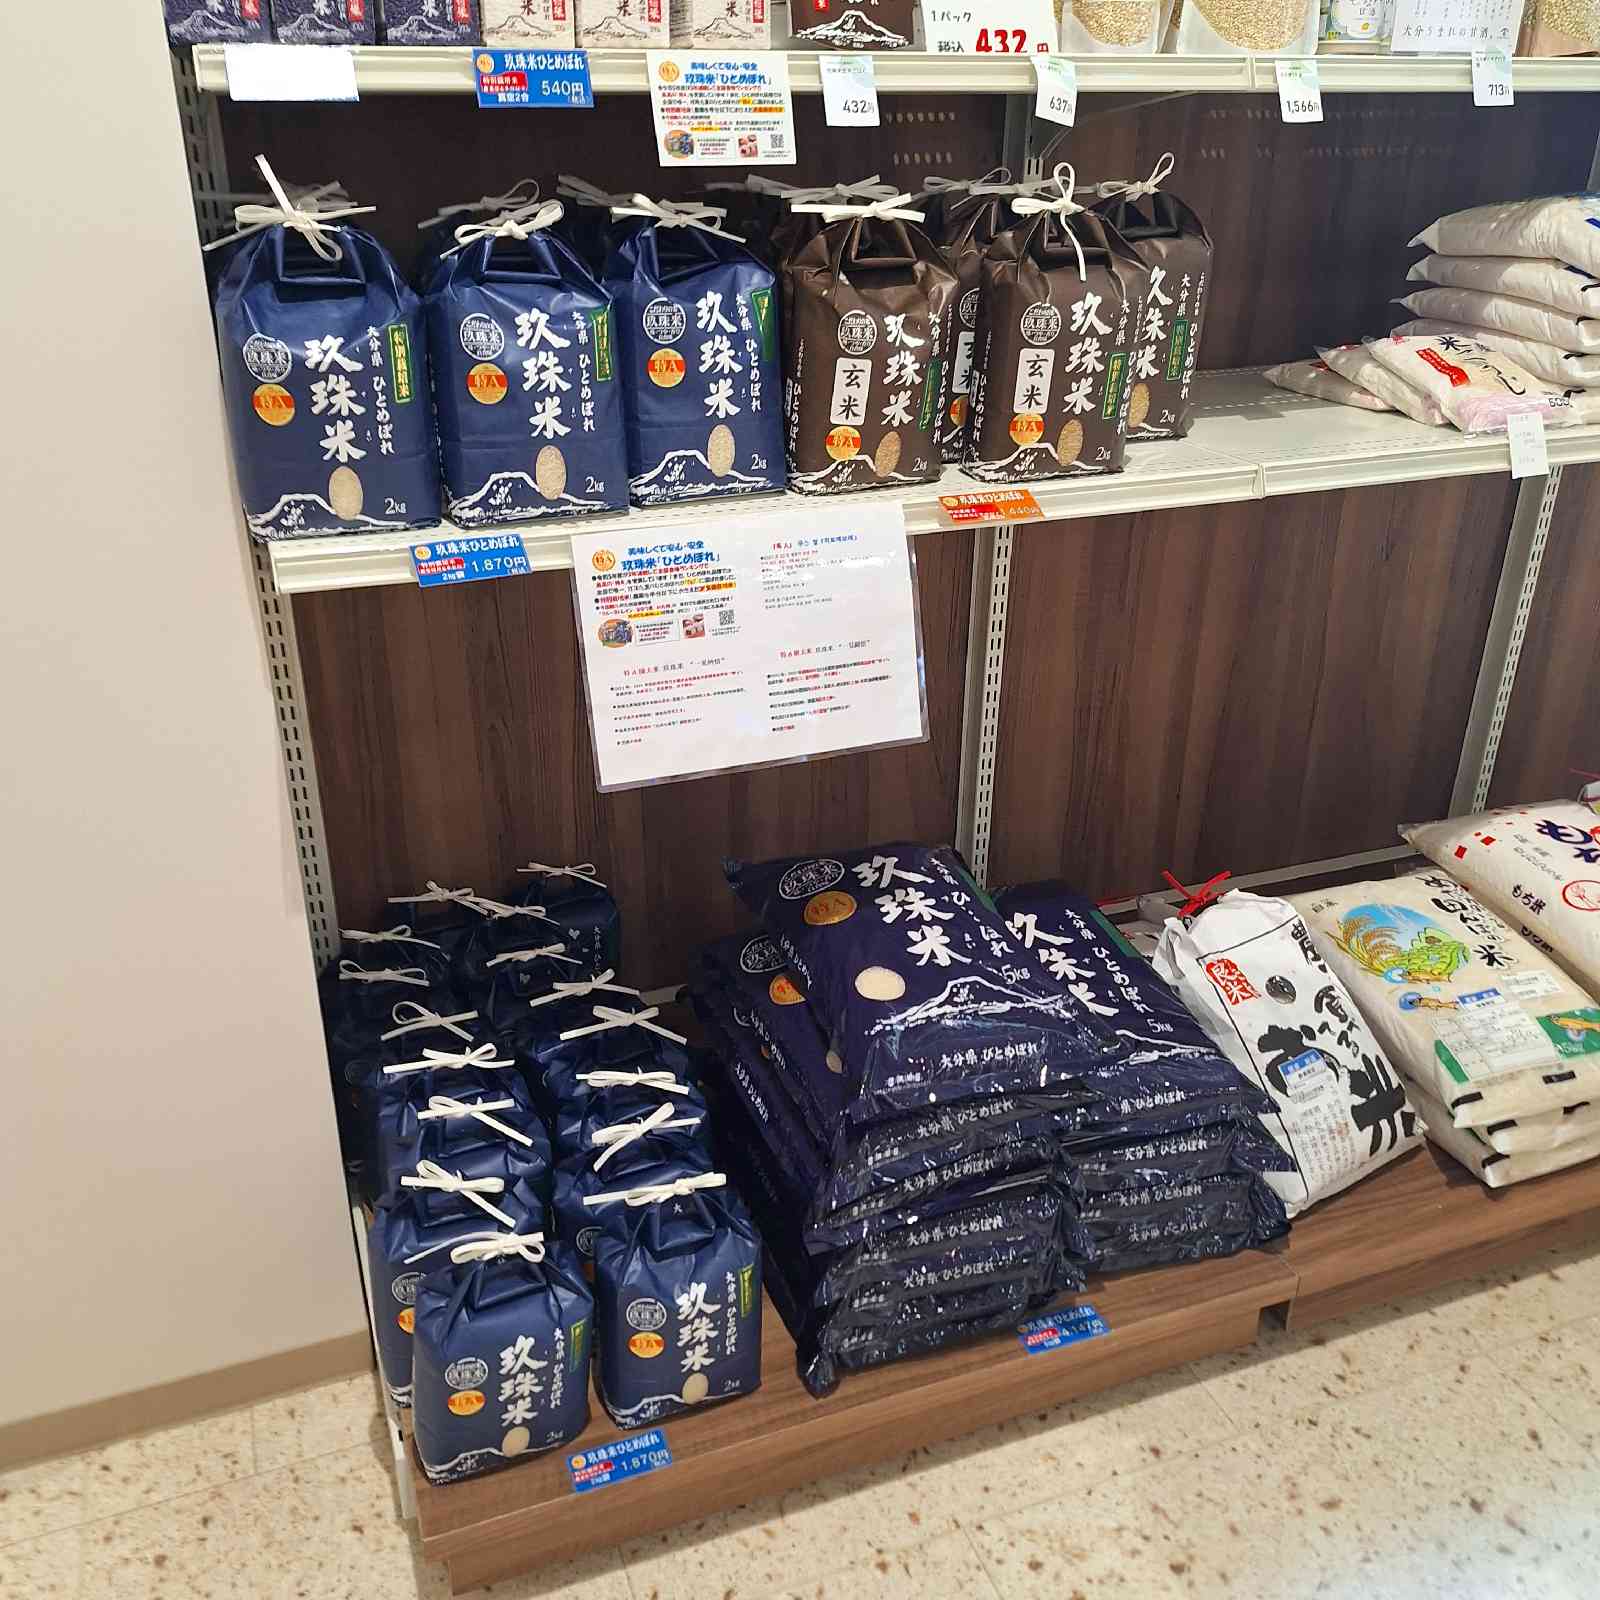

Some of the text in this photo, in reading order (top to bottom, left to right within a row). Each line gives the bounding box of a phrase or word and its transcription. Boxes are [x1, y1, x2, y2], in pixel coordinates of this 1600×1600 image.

[931, 11, 972, 22] 1パック
[938, 41, 965, 52] 税込
[975, 28, 1028, 52] 432
[504, 53, 584, 70] 玖珠米ひとめぼれ
[542, 80, 584, 97] 540円
[695, 290, 744, 418] 玖珠米
[1062, 291, 1113, 415] 玖珠米
[1180, 323, 1197, 400] ひとめぼれ
[514, 308, 571, 439] 玖珠米
[745, 338, 761, 412] ひとめぼれ
[880, 313, 926, 428] 玖珠米
[1020, 354, 1049, 410] 玄米
[304, 335, 367, 463] 玖珠米
[579, 354, 595, 432] ひとめぼれ
[837, 363, 866, 422] 玄米
[933, 360, 949, 445] ひとめぼれ
[1117, 351, 1137, 435] ひとめぼれ
[372, 376, 394, 455] ひとめぼれ
[1160, 409, 1175, 423] 2kg
[751, 453, 767, 470] 2kg
[912, 457, 928, 471] 2kg
[1096, 446, 1112, 461] 2kg
[585, 476, 605, 493] 2kg
[385, 498, 407, 515] 2kg
[435, 536, 520, 557] 玖珠米ひとめぼれ
[621, 552, 720, 571] 玖珠米「ひとめぼれ」
[628, 540, 704, 556] 美味しくて安心・安全
[472, 556, 526, 573] 1,870円
[852, 856, 972, 966] 玖珠米
[1511, 884, 1546, 916] もち米
[1001, 964, 1030, 985] 5kg
[1092, 947, 1154, 1013] ひとめぼれ
[1147, 1019, 1174, 1033] 5kg
[940, 1048, 977, 1069] 大分県
[957, 1099, 1014, 1122] ひとめぼれ
[1135, 1089, 1186, 1109] ひとめぼれ
[1160, 1139, 1207, 1155] ひとめぼれ
[903, 1159, 995, 1192] 大分県 ひとめぼれ
[906, 1215, 1003, 1246] 大分県 ひとめぼれ
[903, 1262, 995, 1288] 大分県 ひとめぼれ
[676, 1282, 721, 1373] 玖珠米
[725, 1306, 737, 1355] ひとめぼれ
[498, 1335, 548, 1426] 玖珠米
[551, 1364, 564, 1409] ひとめぼれ
[587, 1433, 660, 1464] 玖珠米ひとめぼれ
